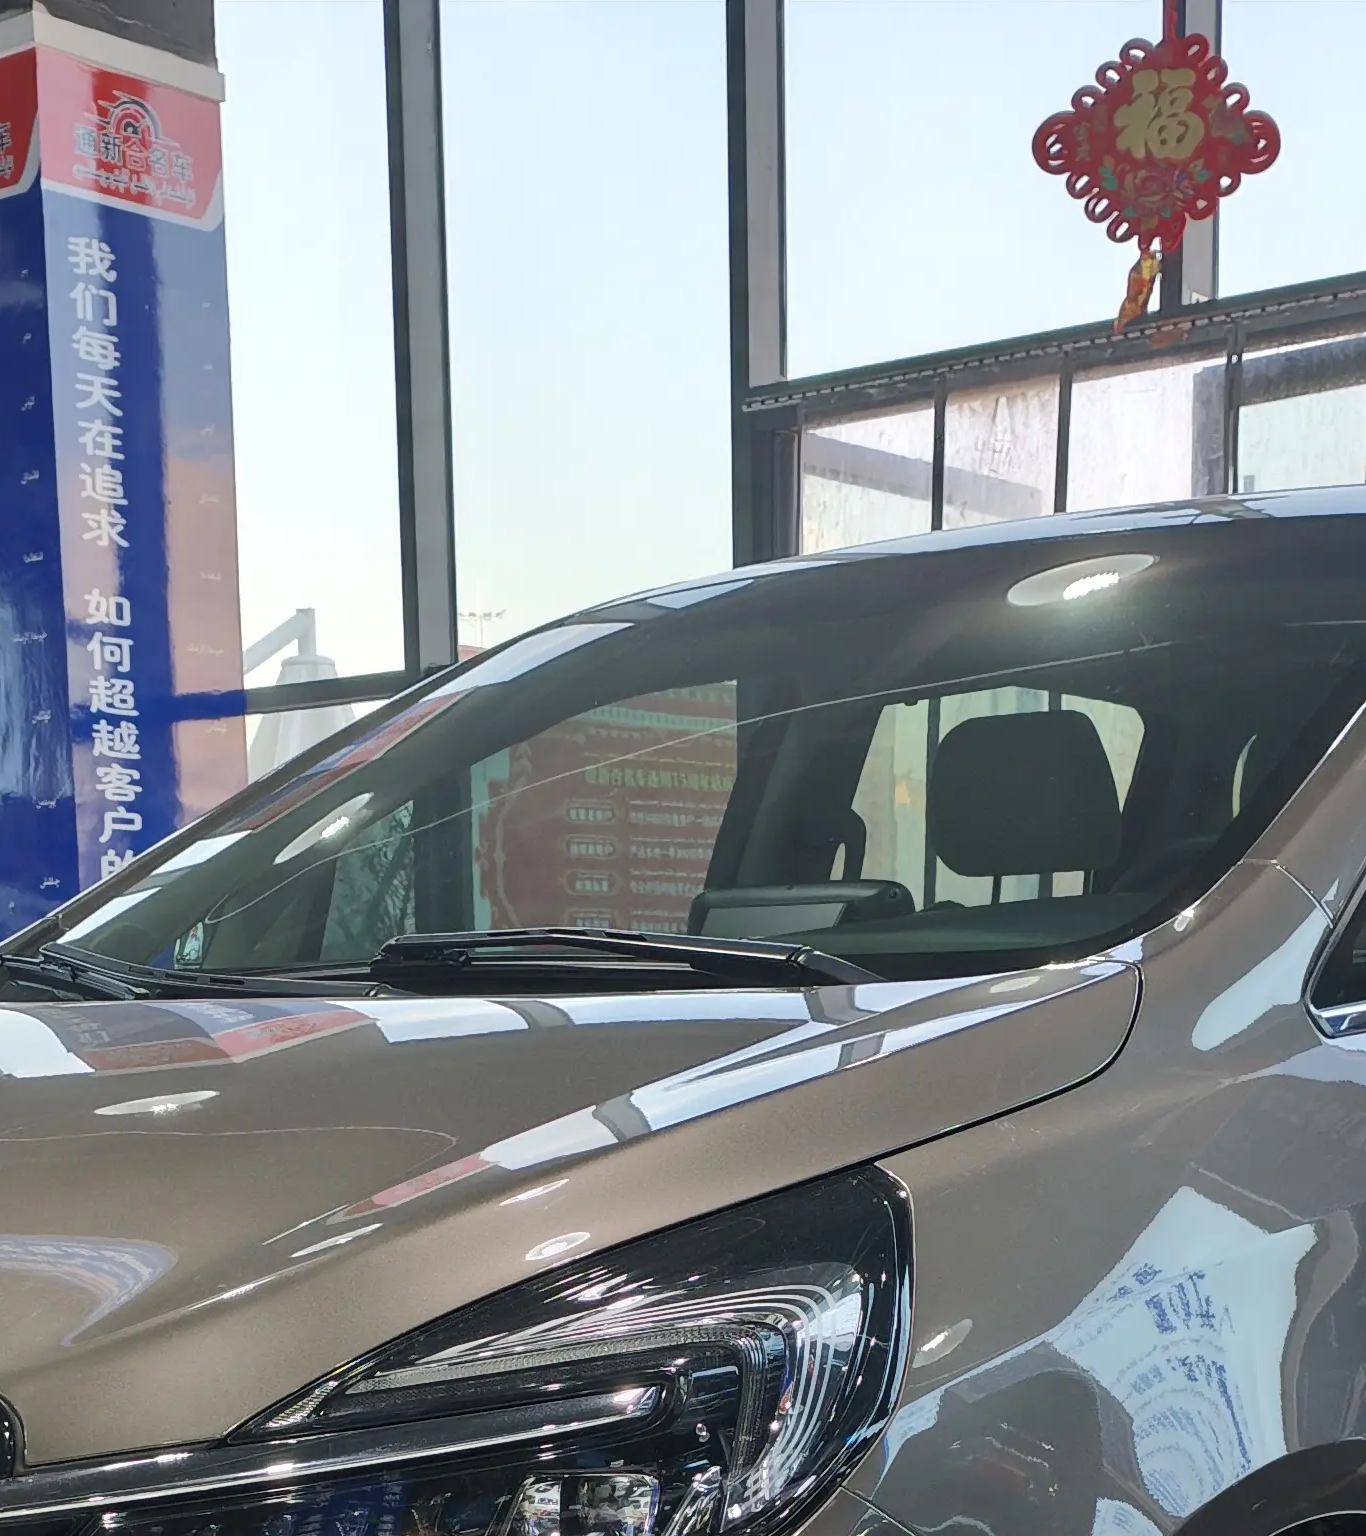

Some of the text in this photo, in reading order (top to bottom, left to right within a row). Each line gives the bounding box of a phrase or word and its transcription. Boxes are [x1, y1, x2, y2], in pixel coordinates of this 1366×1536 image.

[1113, 67, 1206, 160] 福
[67, 236, 131, 549] 我们每天在追求
